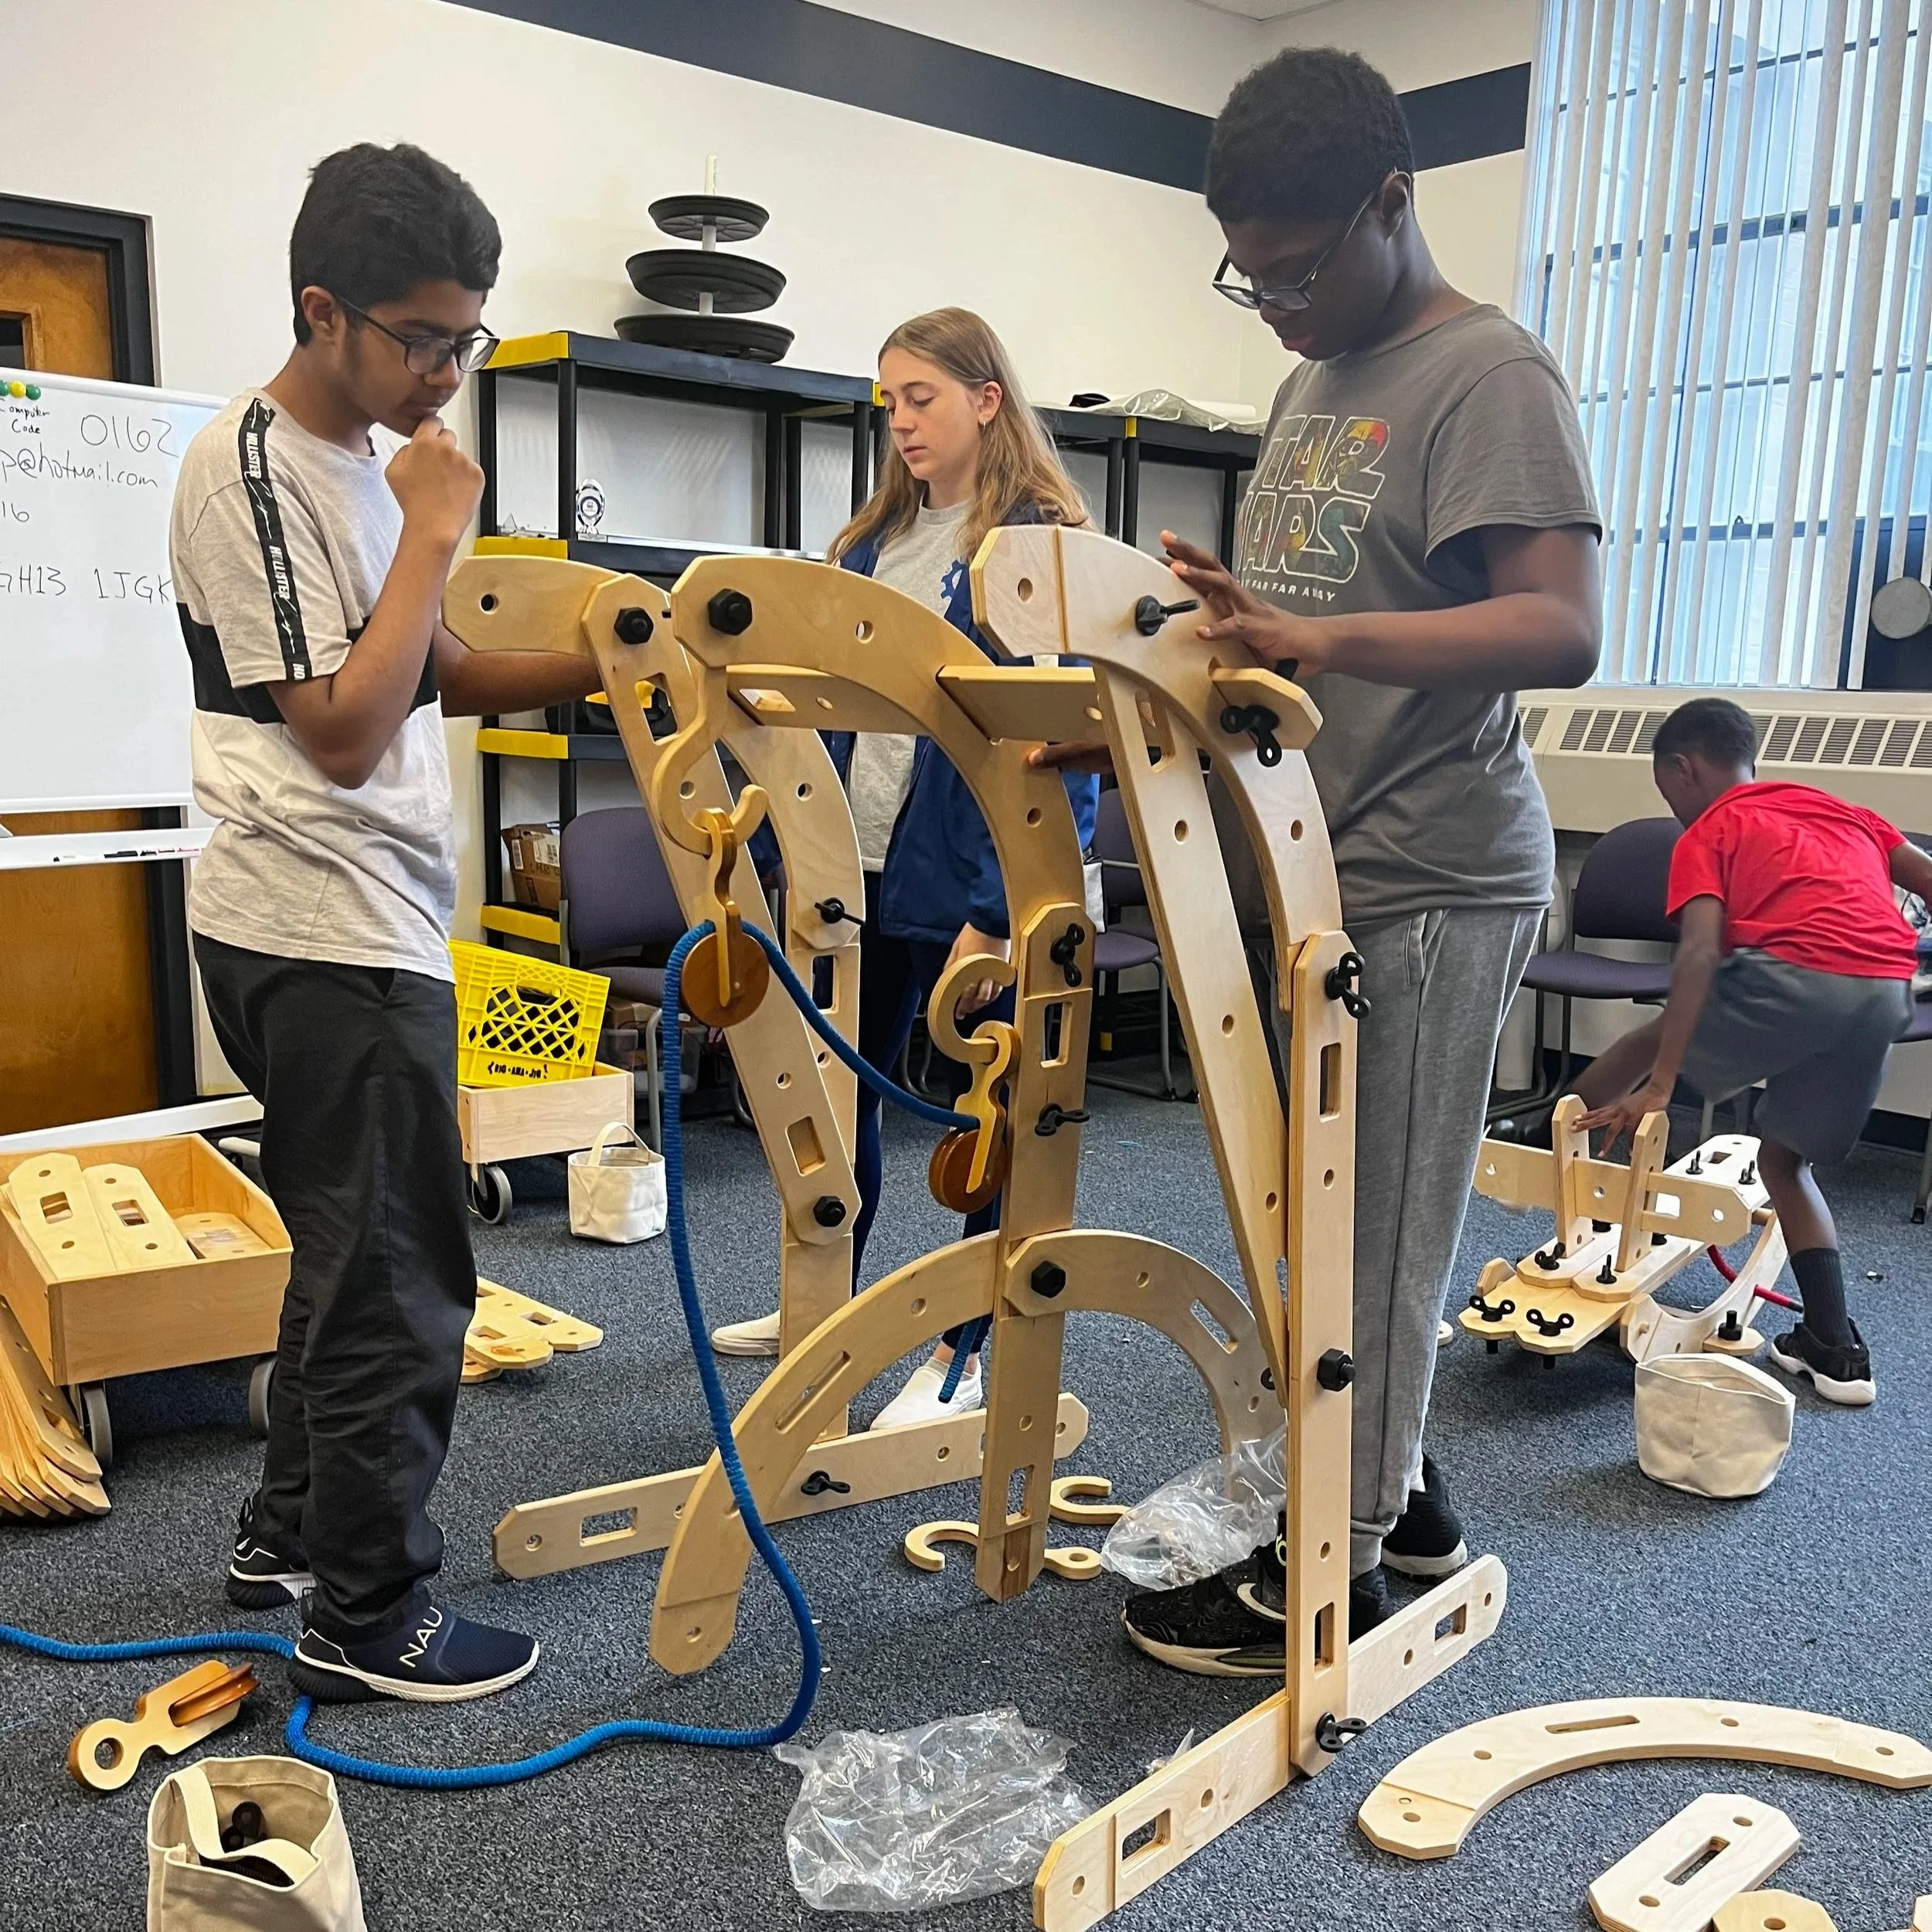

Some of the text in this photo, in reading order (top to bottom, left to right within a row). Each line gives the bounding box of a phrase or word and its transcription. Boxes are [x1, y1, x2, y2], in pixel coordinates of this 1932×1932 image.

[12, 419, 41, 434] Code
[81, 415, 179, 457] 0162
[246, 431, 263, 480] HOLLISTER
[269, 545, 291, 600] HOLLISTER
[1271, 582, 1298, 594] FAR
[1301, 586, 1335, 602] AWAY
[399, 1606, 444, 1668] NAU
